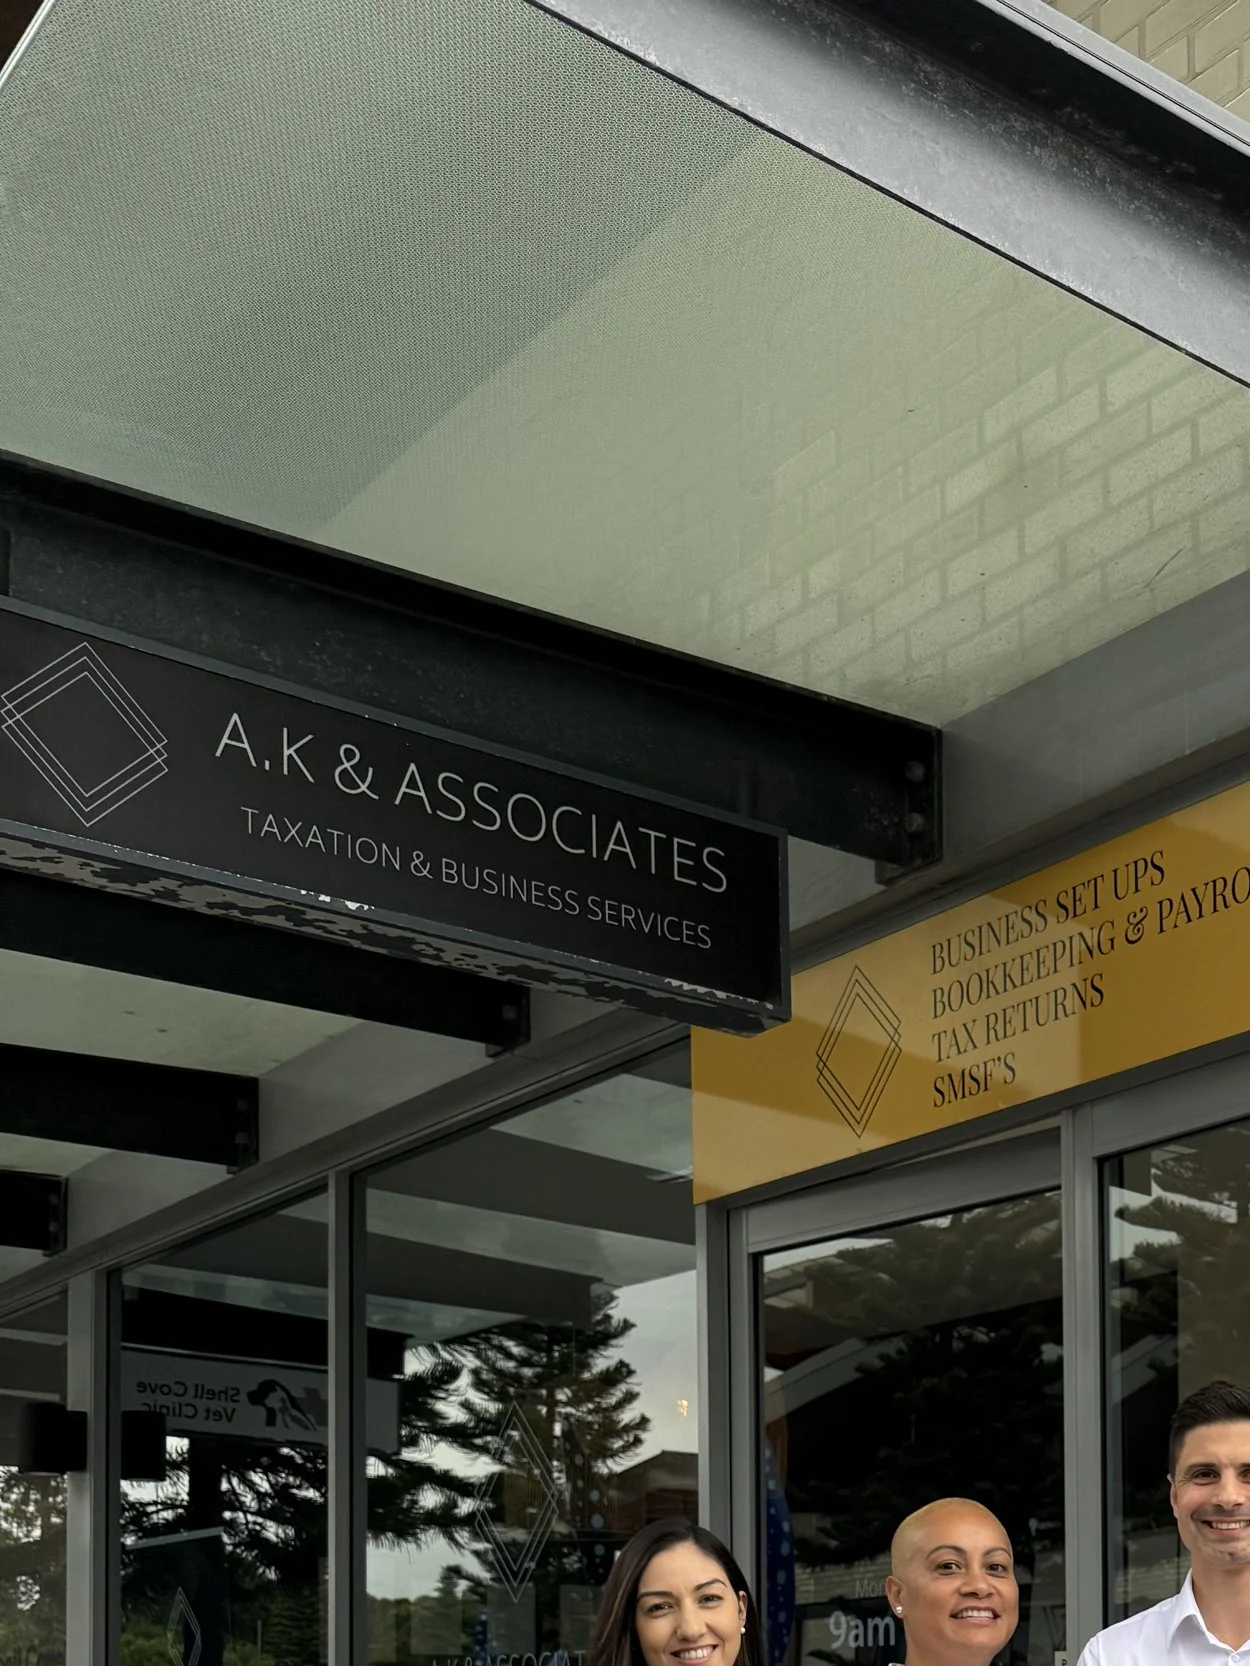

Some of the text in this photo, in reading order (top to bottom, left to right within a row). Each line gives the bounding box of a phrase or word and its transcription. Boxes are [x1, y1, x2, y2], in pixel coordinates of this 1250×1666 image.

[215, 712, 729, 895] A.K & ASSOCIATES
[241, 806, 713, 949] TAXATION & BUSINESS SERVICES
[930, 849, 1167, 975] BUSINESS SET UPS
[932, 920, 1117, 1020] BOOKKEEPING
[1125, 907, 1150, 945] &
[932, 972, 1106, 1063] TAX RETURNS
[933, 1053, 1017, 1109] SMSF'S
[829, 1611, 896, 1649] 9am
